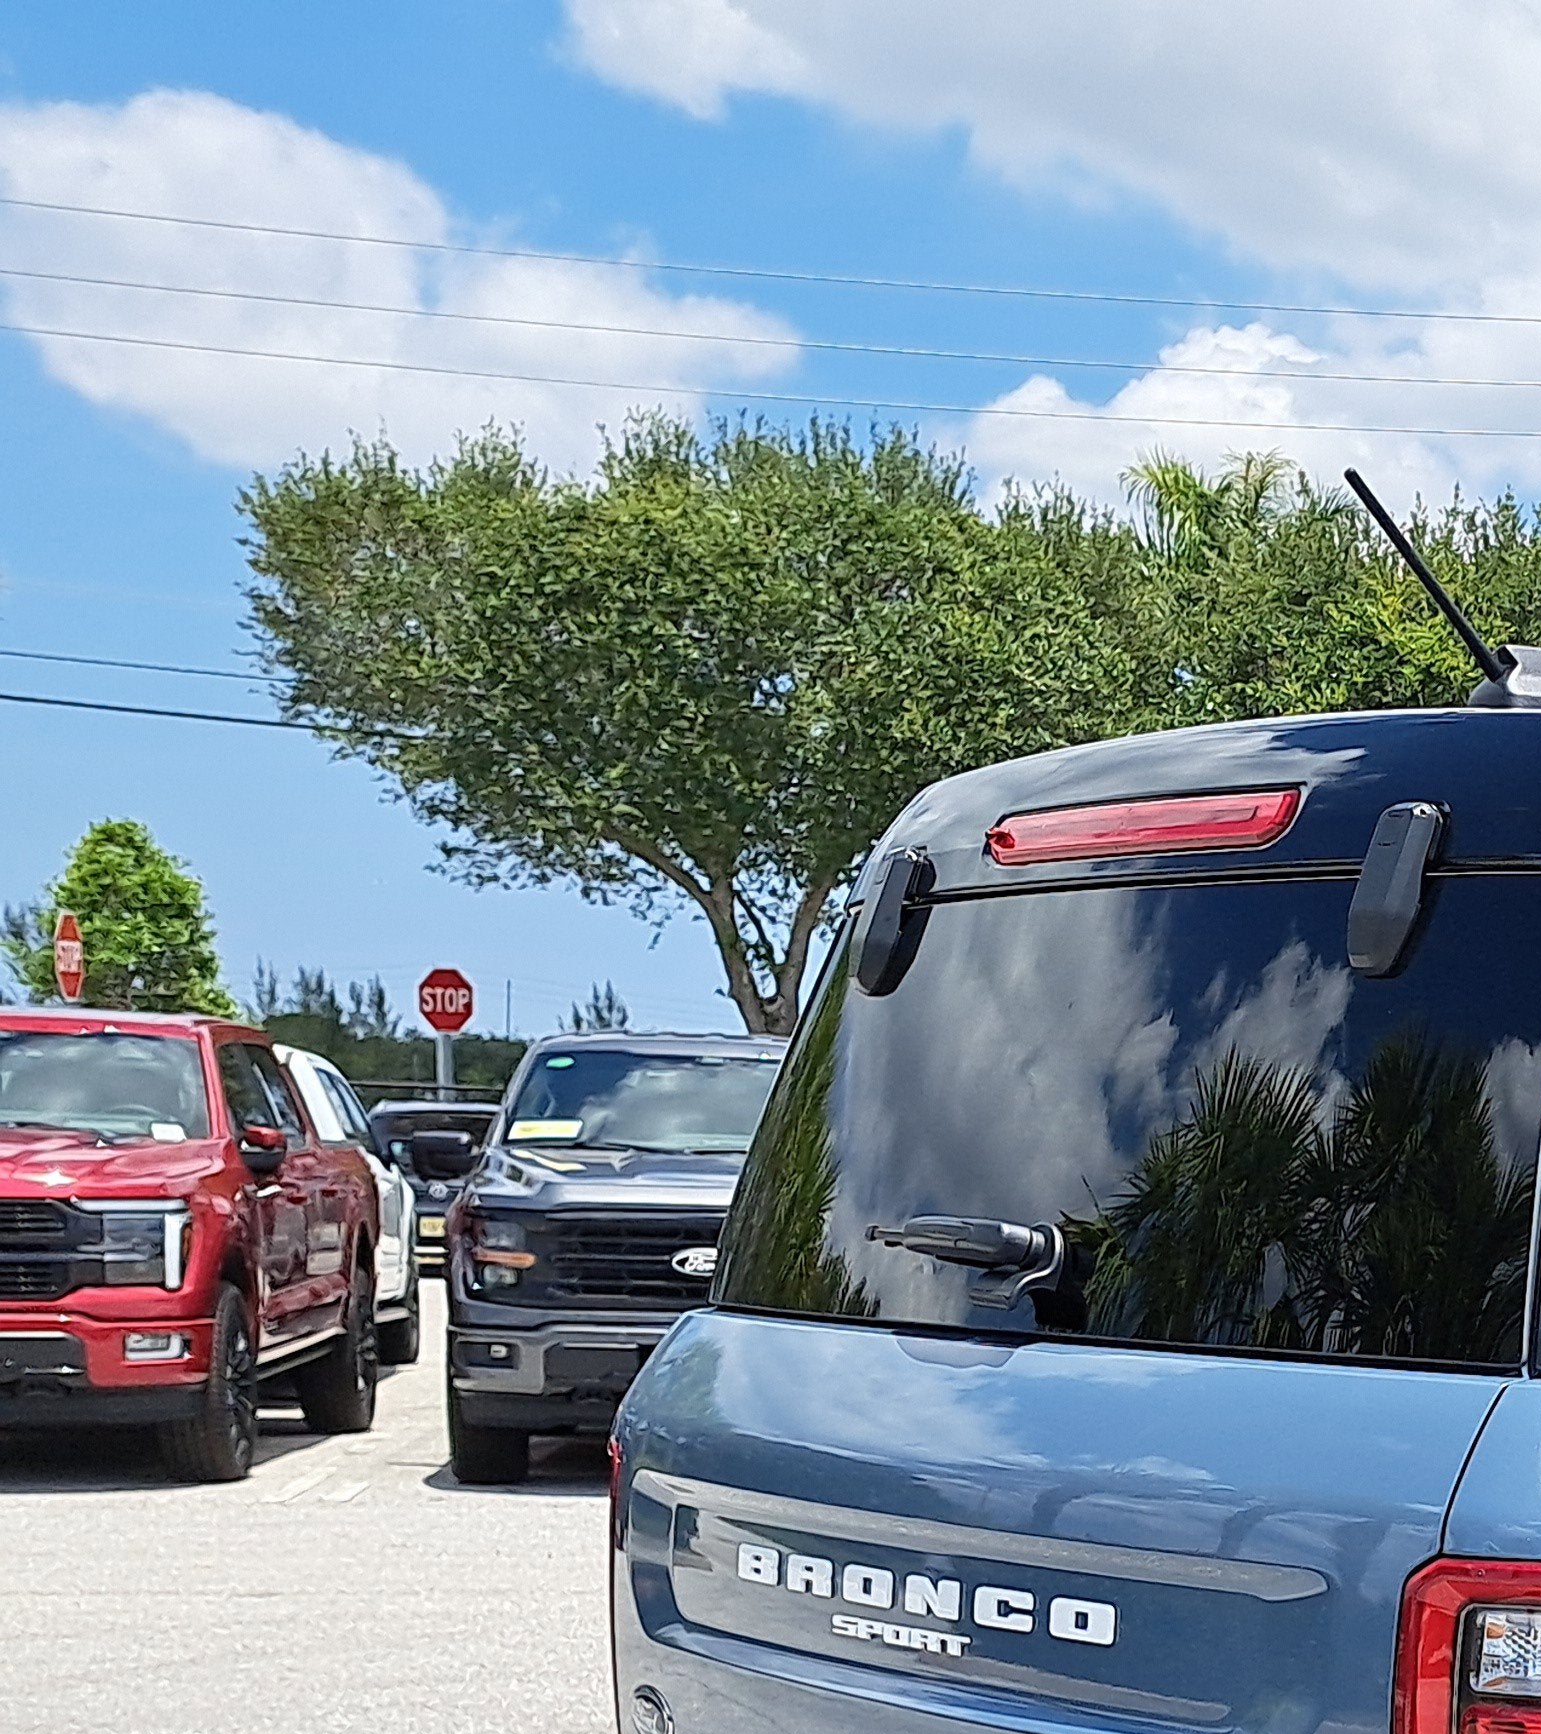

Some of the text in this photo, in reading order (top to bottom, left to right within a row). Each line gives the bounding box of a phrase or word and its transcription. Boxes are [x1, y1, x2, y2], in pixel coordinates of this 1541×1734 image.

[421, 986, 470, 1014] STOP
[736, 1542, 1118, 1647] BRONCO
[831, 1613, 972, 1657] SPORT
